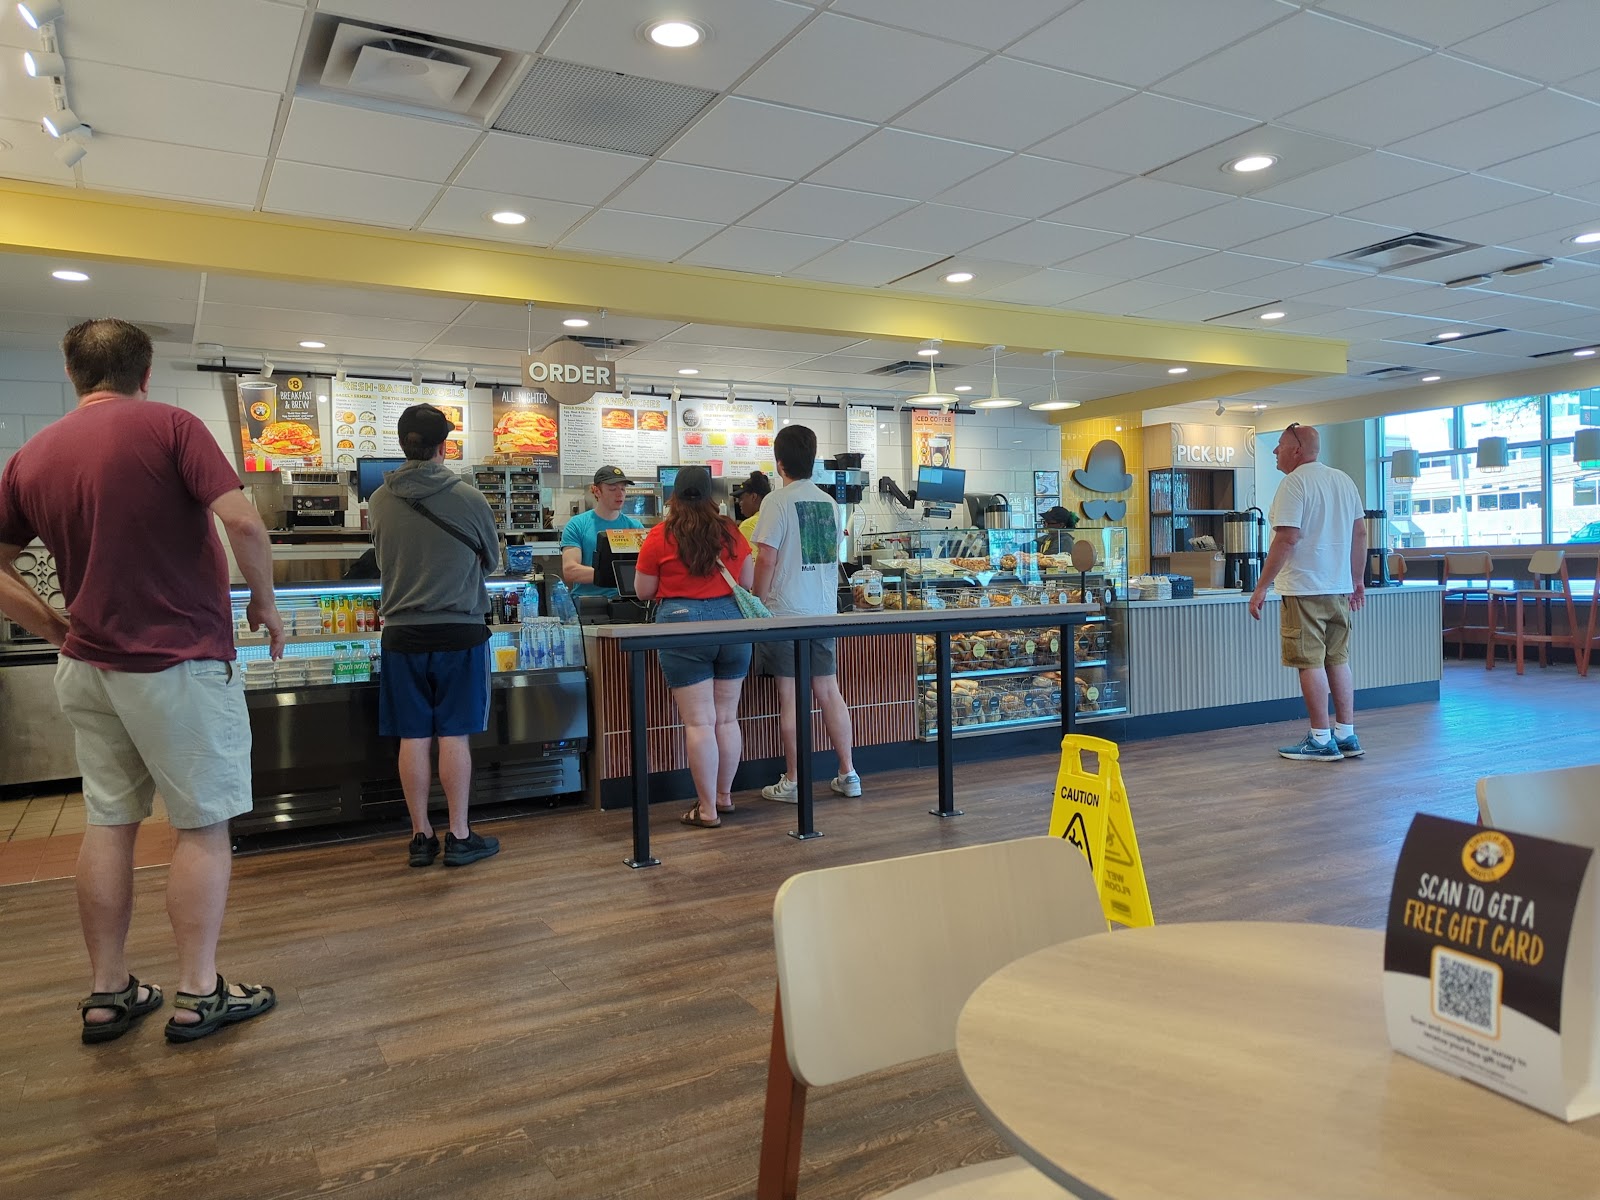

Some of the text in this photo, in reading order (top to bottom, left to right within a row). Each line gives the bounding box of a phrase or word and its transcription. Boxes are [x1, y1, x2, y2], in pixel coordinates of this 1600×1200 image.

[528, 361, 611, 386] ORDER
[289, 380, 300, 390] $8
[279, 391, 312, 401] BREAKFAST
[422, 386, 464, 398] BAGELS
[501, 390, 549, 404] ALL-NIGHTER
[284, 400, 310, 410] & BREW
[702, 403, 753, 413] BEVERAGES
[849, 409, 875, 418] LUNCH
[1177, 444, 1235, 464] PICK UP
[1061, 786, 1100, 808] CAUTION
[1418, 872, 1535, 930] SCAN TO GET A
[1403, 898, 1545, 966] FREE GIFT CARD
